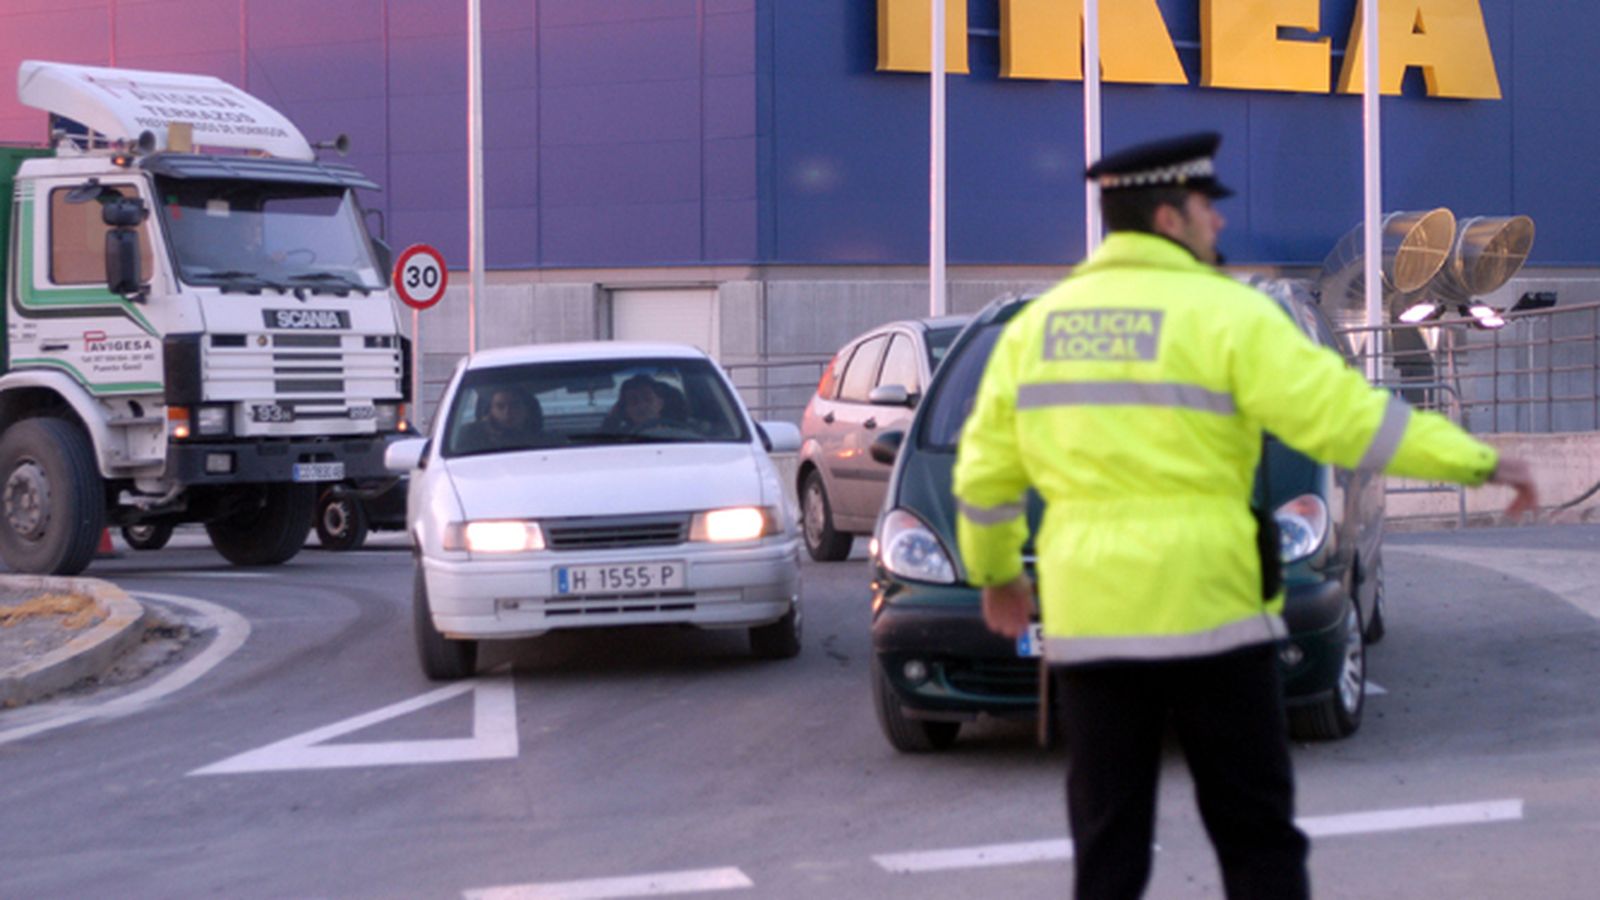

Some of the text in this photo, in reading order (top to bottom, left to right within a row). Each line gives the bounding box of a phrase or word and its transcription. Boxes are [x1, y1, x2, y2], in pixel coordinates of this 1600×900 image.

[406, 265, 438, 289] 30
[276, 310, 341, 328] SCANIA
[1051, 314, 1153, 335] POLICIA
[83, 330, 153, 352] PAVIGESA
[1055, 337, 1137, 357] LOCAL
[572, 565, 674, 590] H 1555 P
